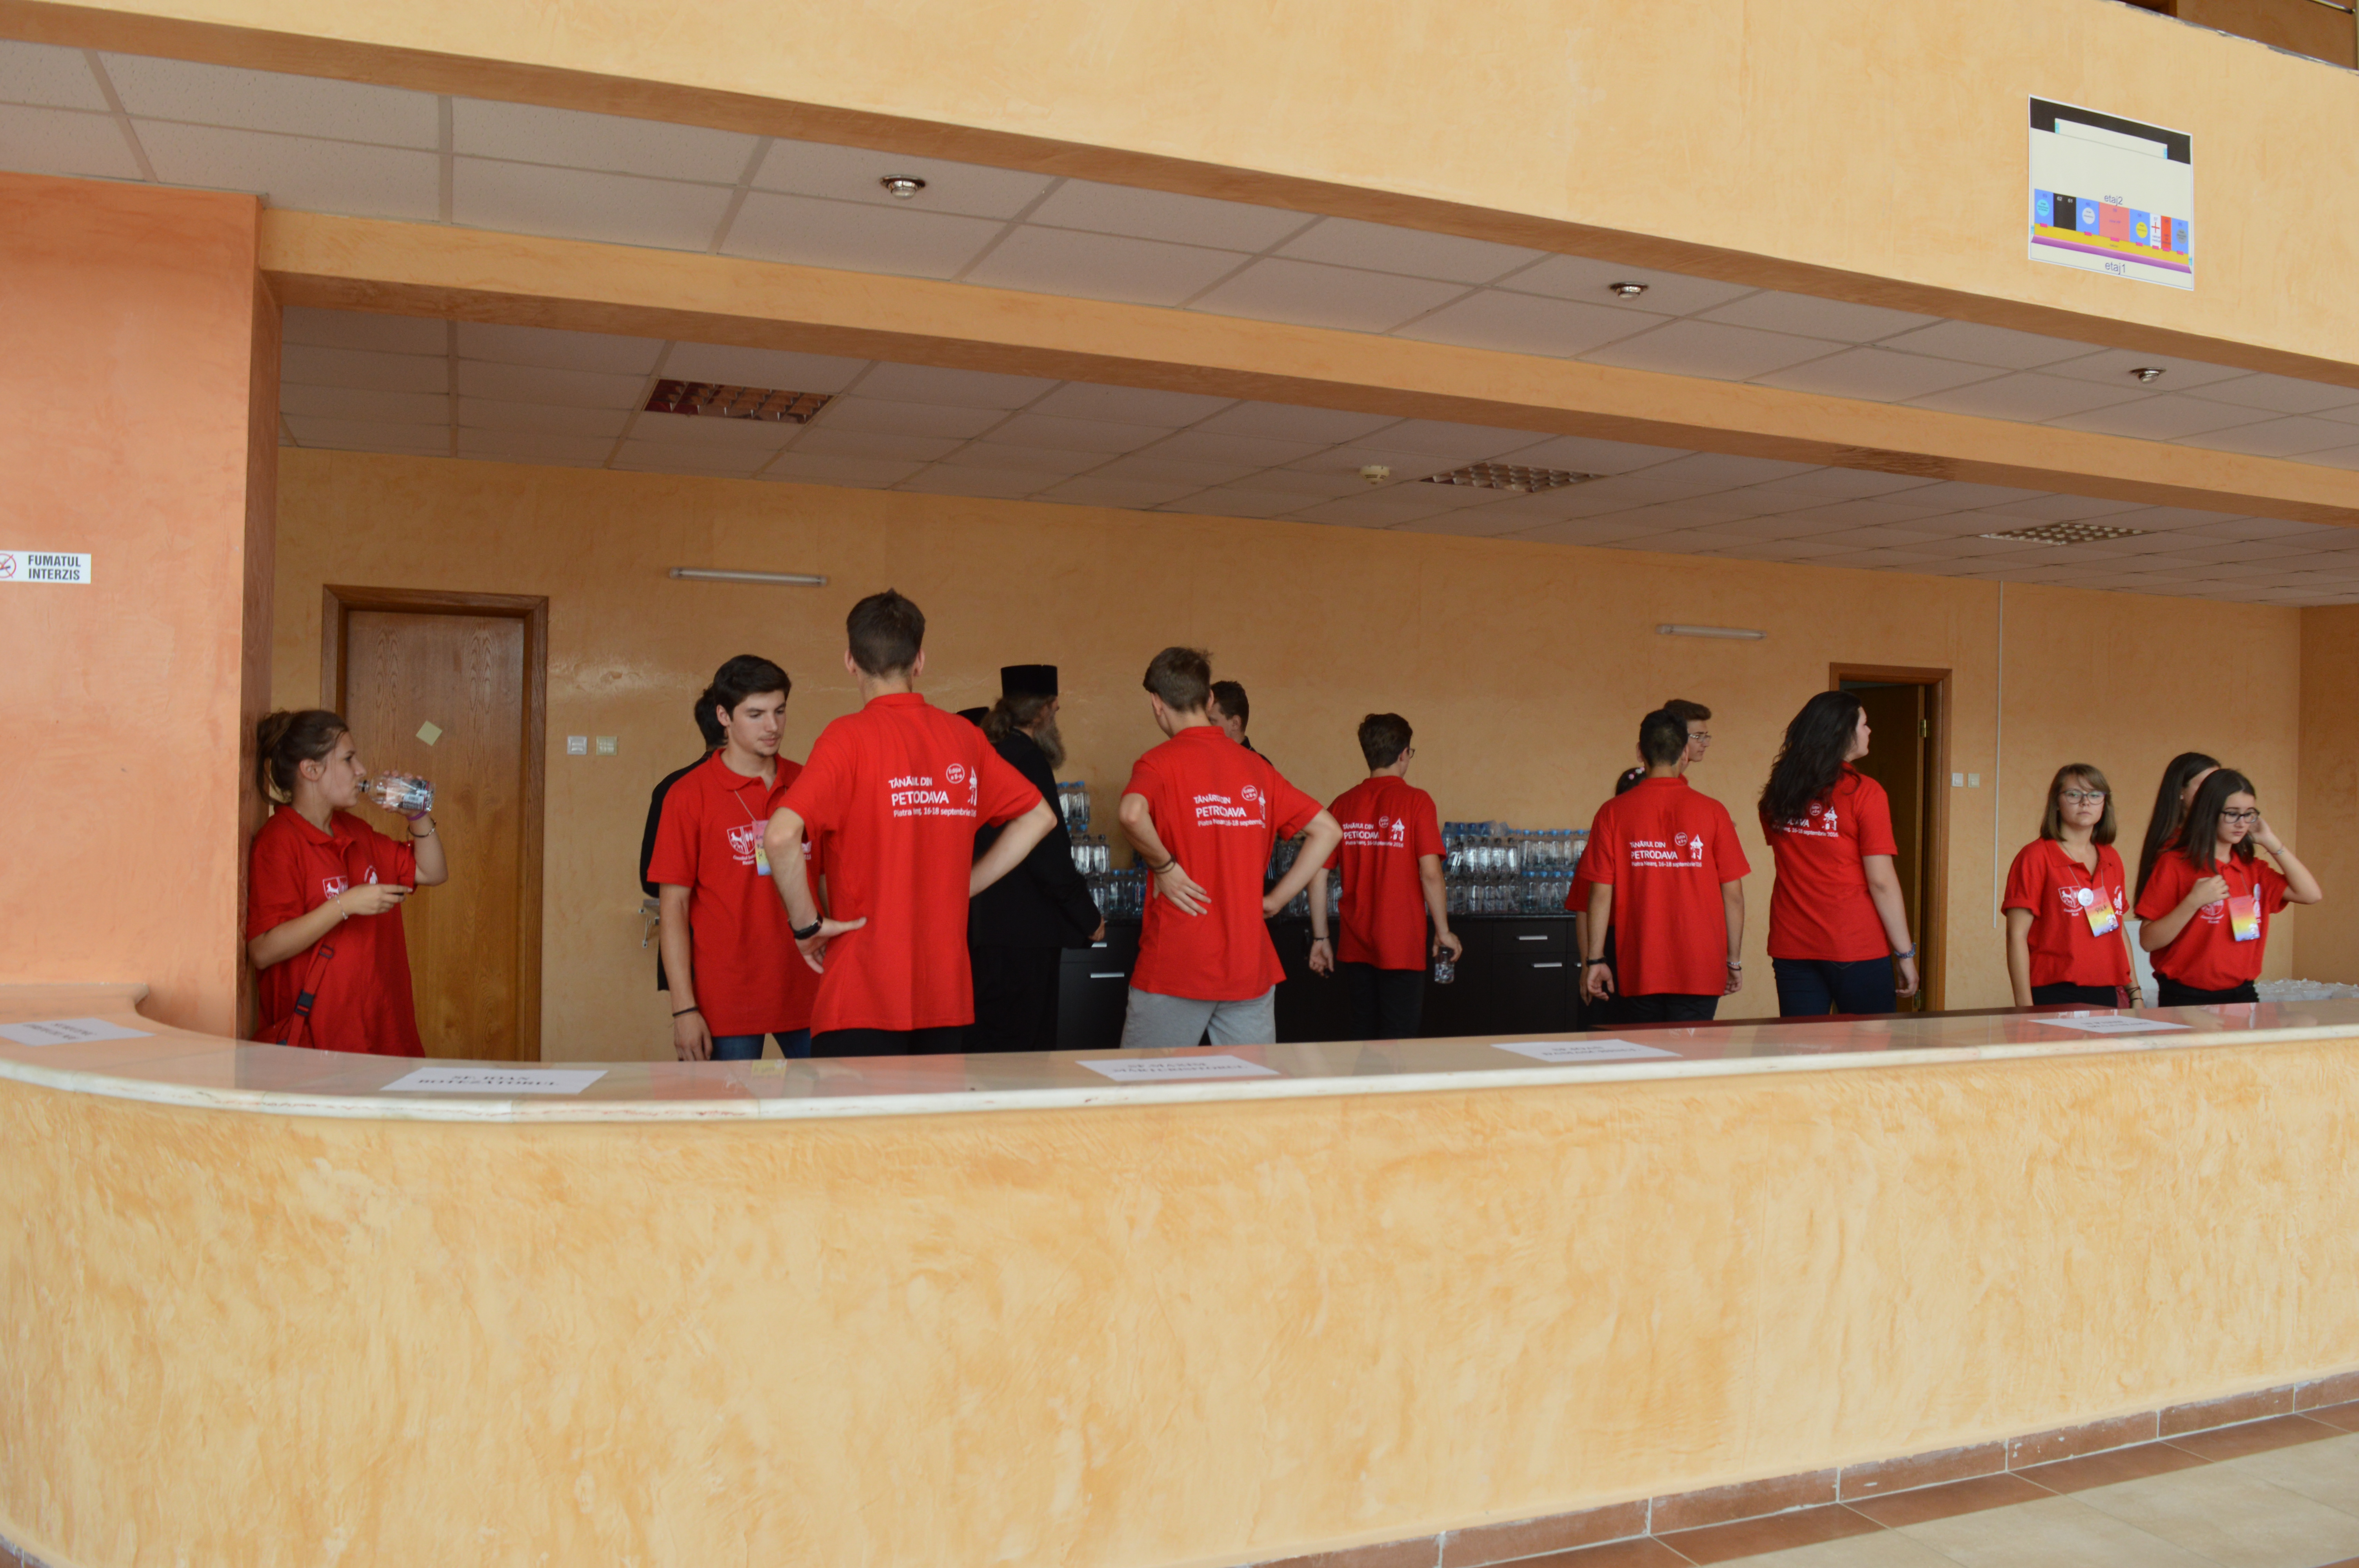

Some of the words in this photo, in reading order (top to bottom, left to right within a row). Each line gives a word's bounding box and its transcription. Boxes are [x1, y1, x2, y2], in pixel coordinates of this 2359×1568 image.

[2104, 194, 2123, 206] etaj2
[2105, 262, 2125, 275] etaj1
[28, 555, 81, 567] FUMATUL
[28, 568, 80, 580] INTERZIS
[920, 777, 932, 786] DIN
[891, 791, 949, 806] PETODAVA
[894, 809, 912, 818] Piatra
[924, 807, 939, 815] 16-18
[941, 808, 970, 817] septembrie
[1631, 850, 1678, 860] PETRODAVA
